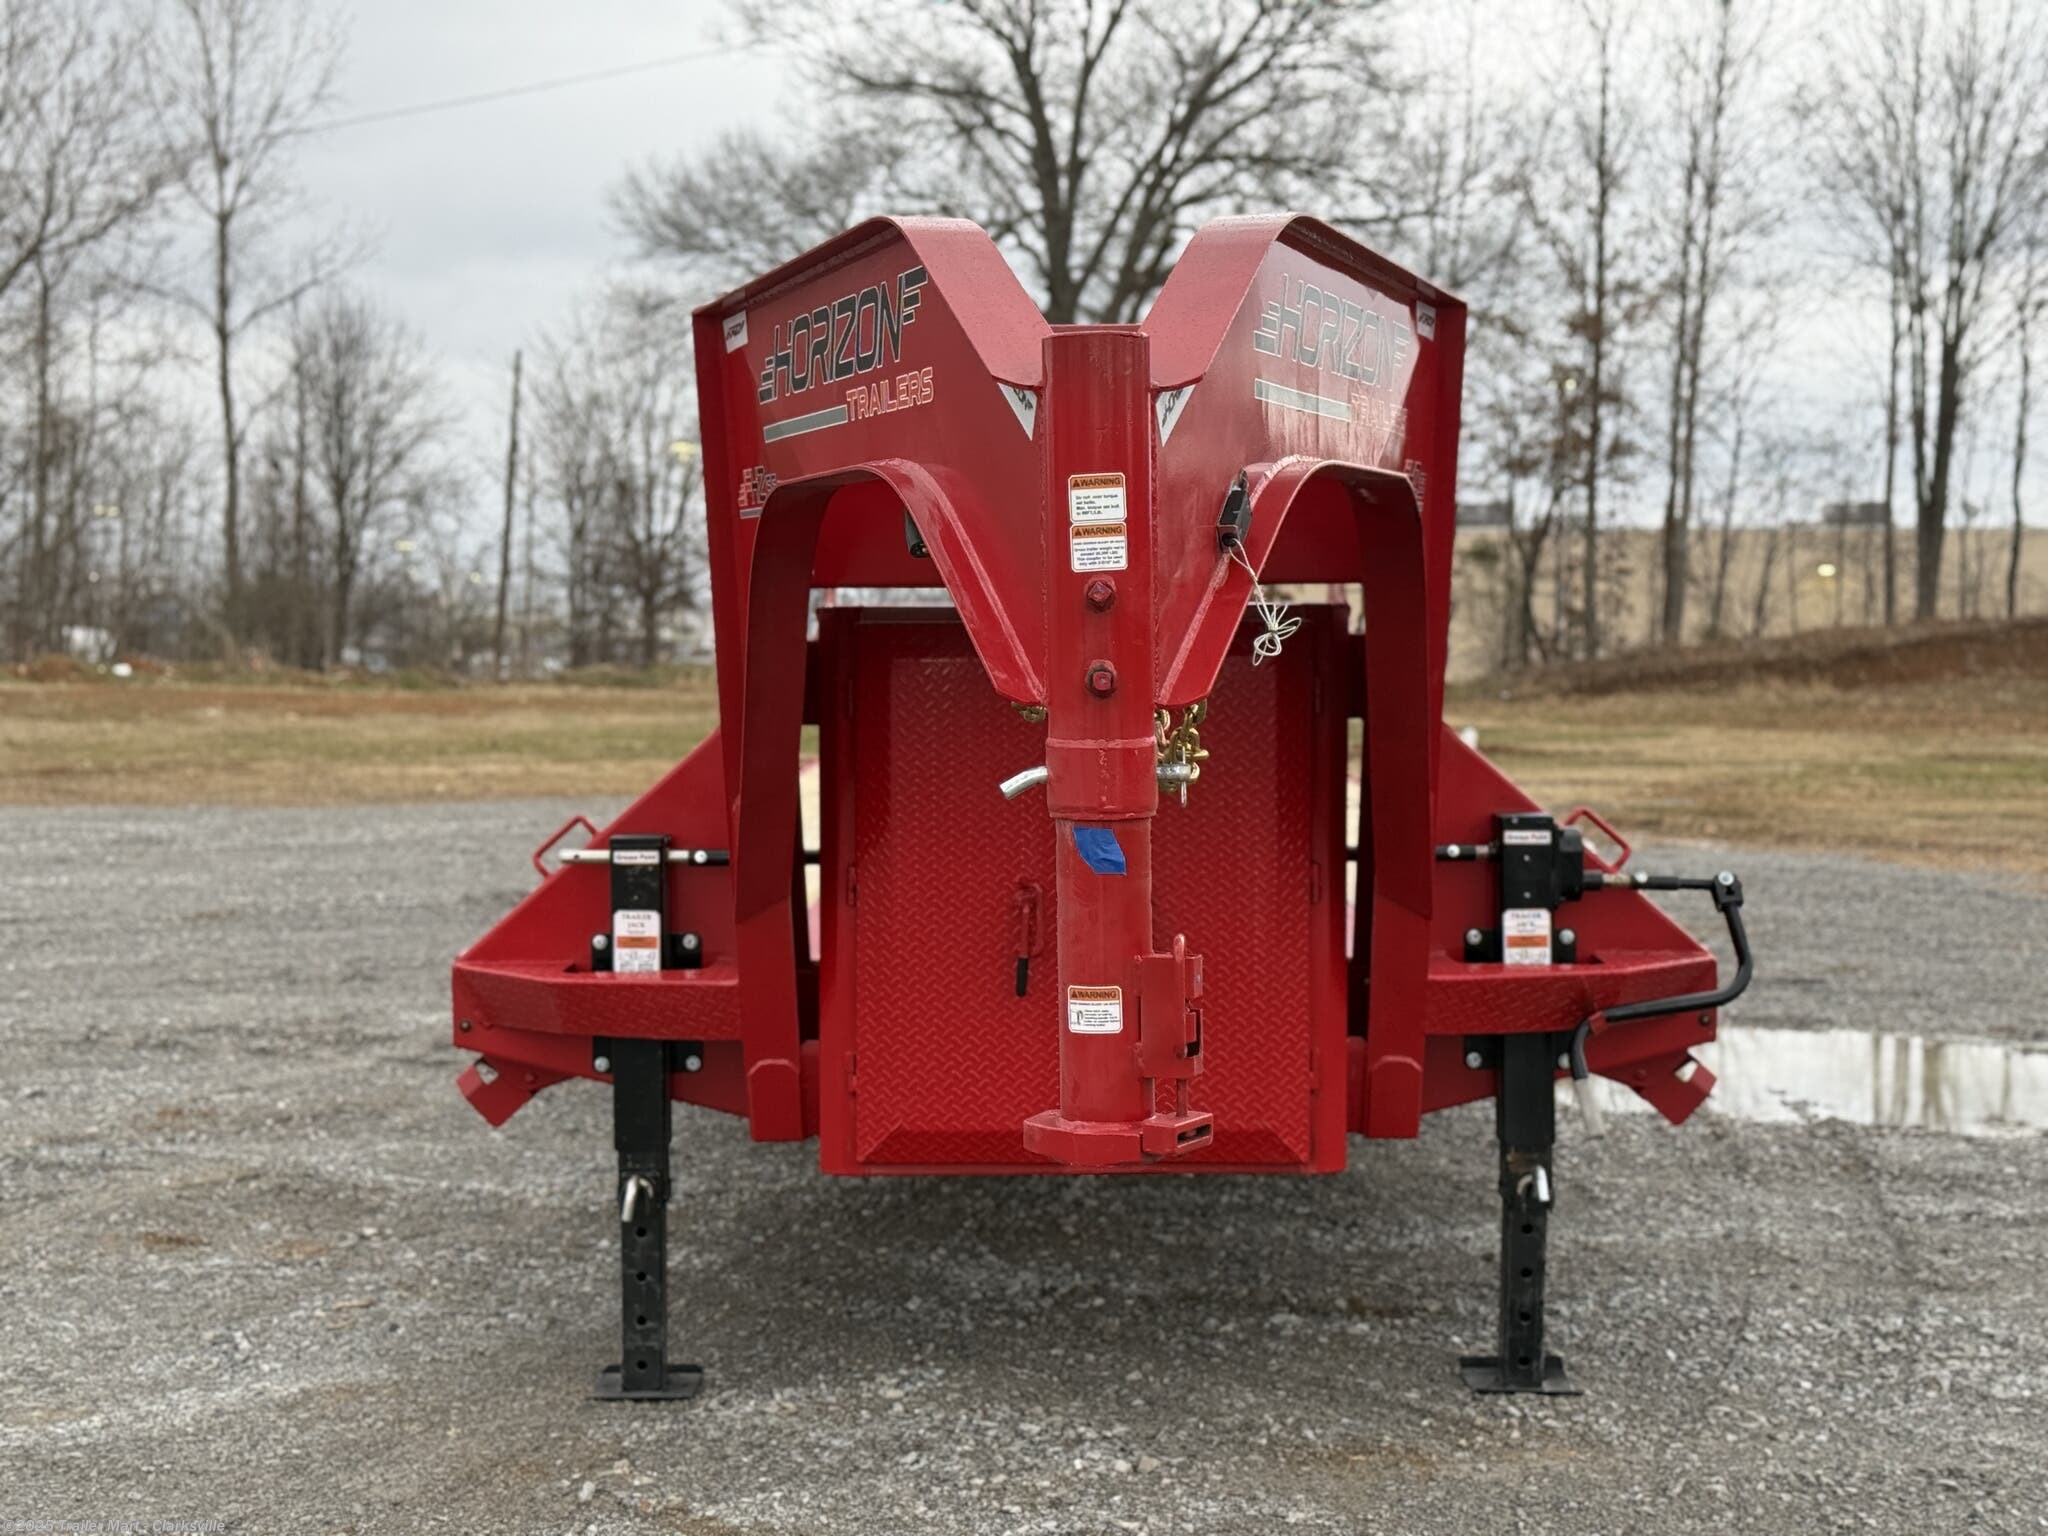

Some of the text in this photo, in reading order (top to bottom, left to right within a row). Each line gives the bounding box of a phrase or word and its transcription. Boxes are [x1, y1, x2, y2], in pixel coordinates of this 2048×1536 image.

[759, 266, 928, 405] HORIZON
[1254, 273, 1410, 391] HORIZON
[846, 367, 934, 421] TRAILERS
[1080, 477, 1121, 487] WARNING
[1082, 526, 1122, 536] WARNING
[1078, 991, 1117, 999] WARNING
